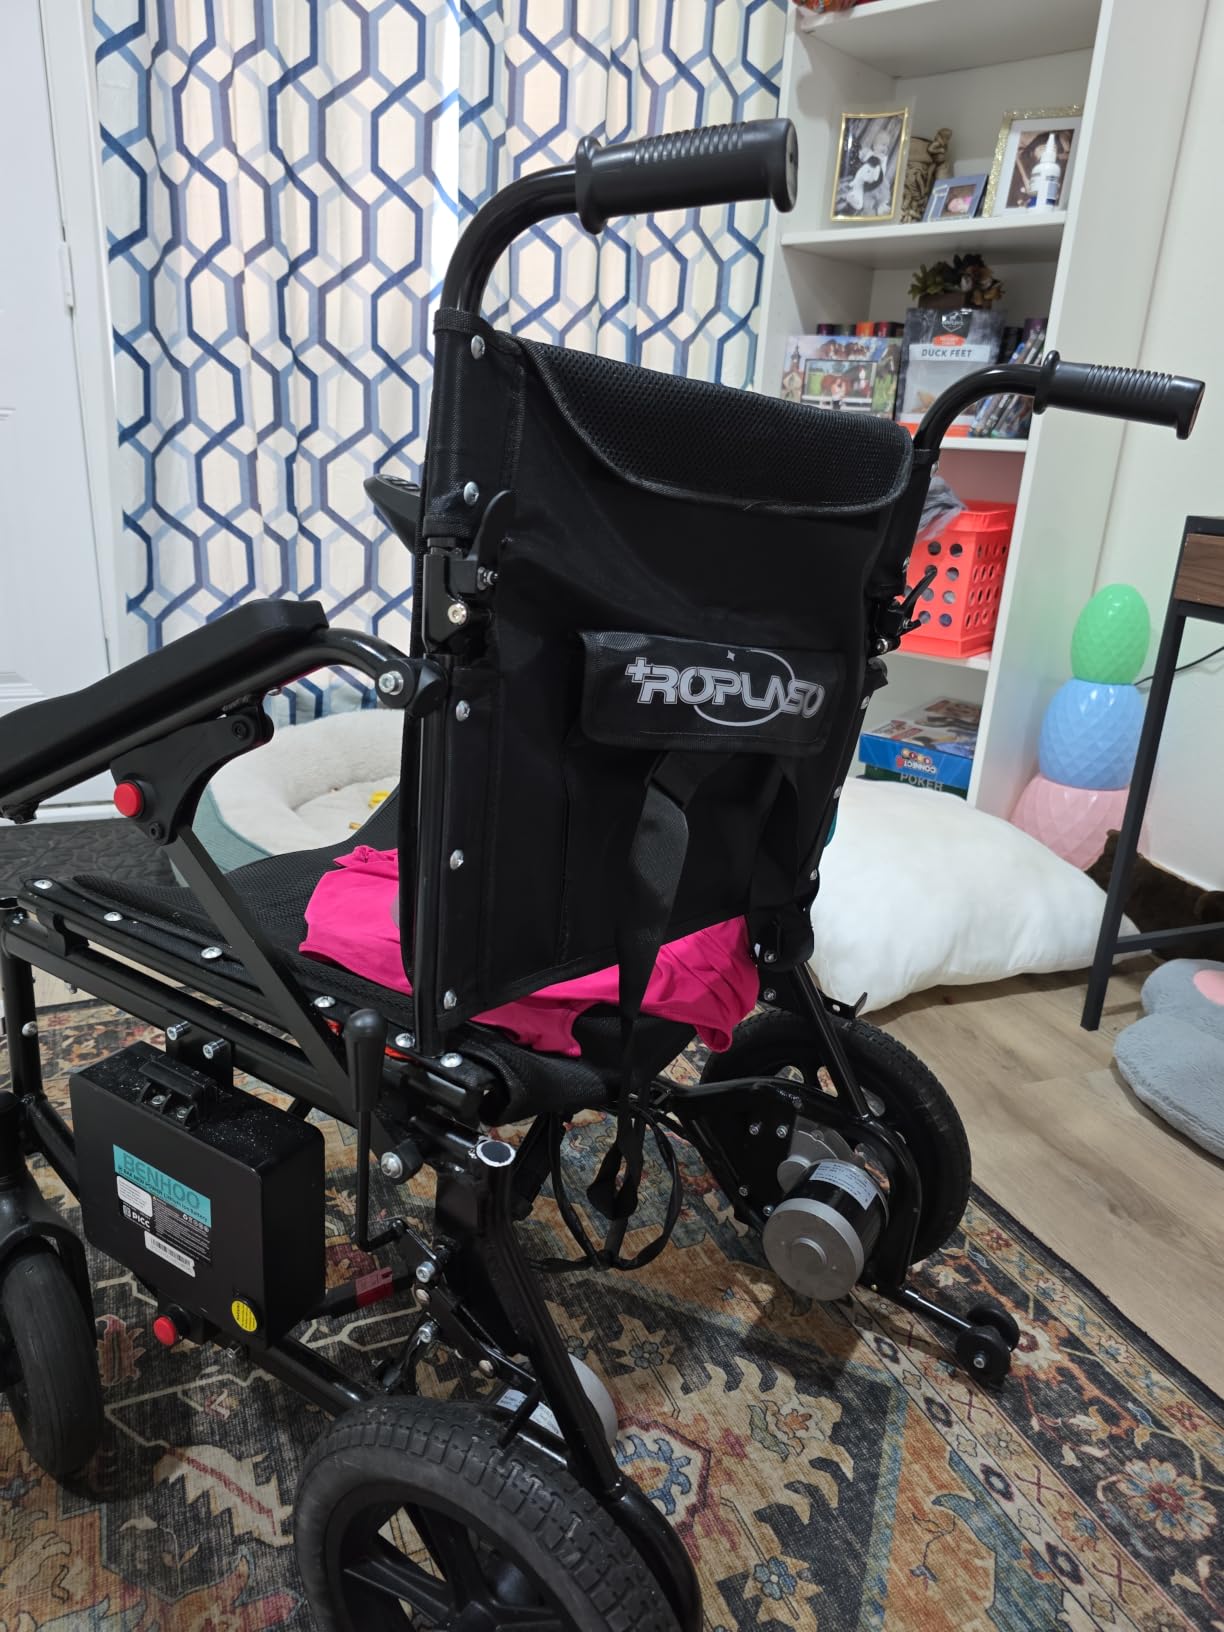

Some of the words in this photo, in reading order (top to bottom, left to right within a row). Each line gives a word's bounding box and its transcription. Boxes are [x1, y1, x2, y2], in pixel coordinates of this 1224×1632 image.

[921, 349, 947, 358] DUCK
[949, 349, 972, 358] FEET
[123, 1152, 200, 1210] BENHOO
